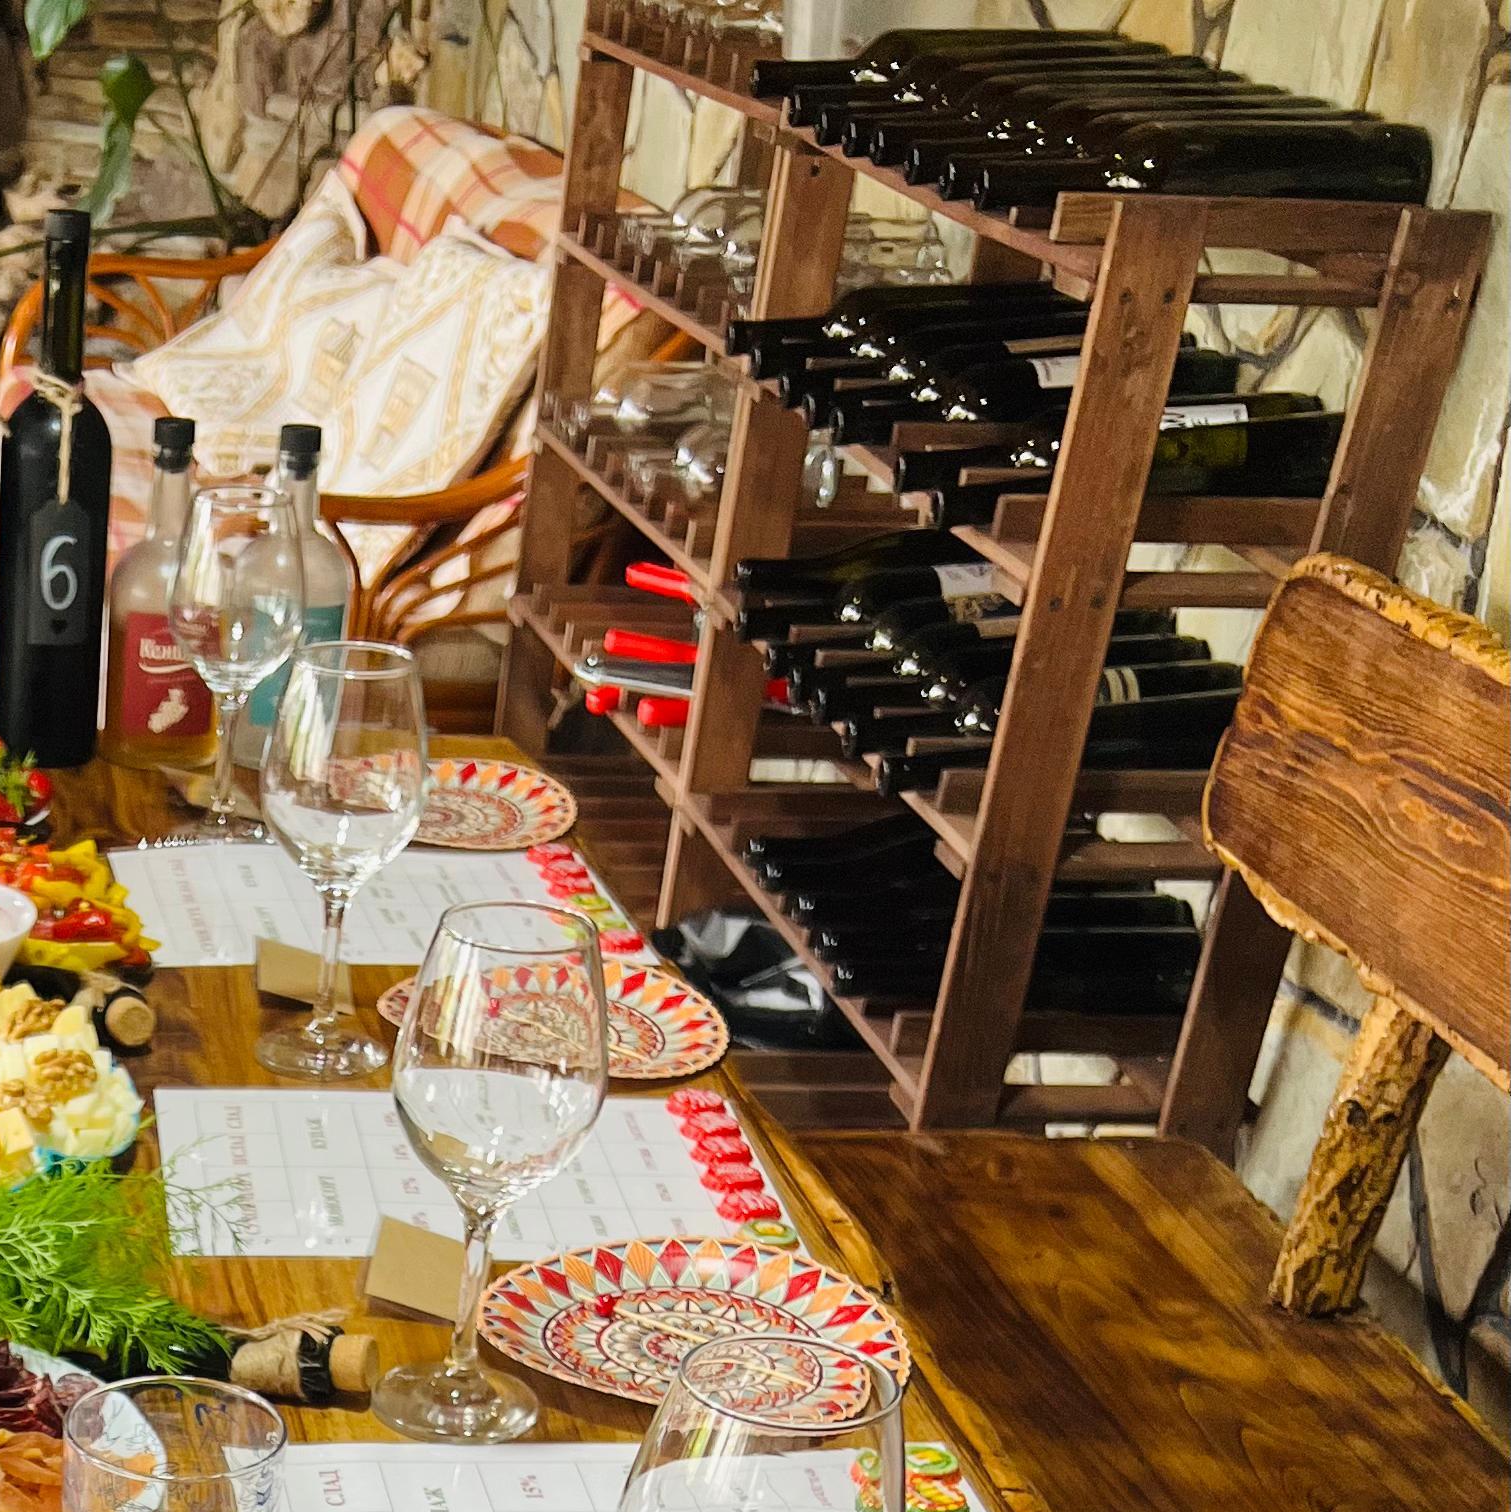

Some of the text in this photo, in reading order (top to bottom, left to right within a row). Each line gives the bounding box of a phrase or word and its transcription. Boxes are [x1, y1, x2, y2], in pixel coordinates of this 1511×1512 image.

[40, 535, 78, 610] 6
[318, 1469, 346, 1506] СЛАД
[519, 1474, 545, 1499] 15%
